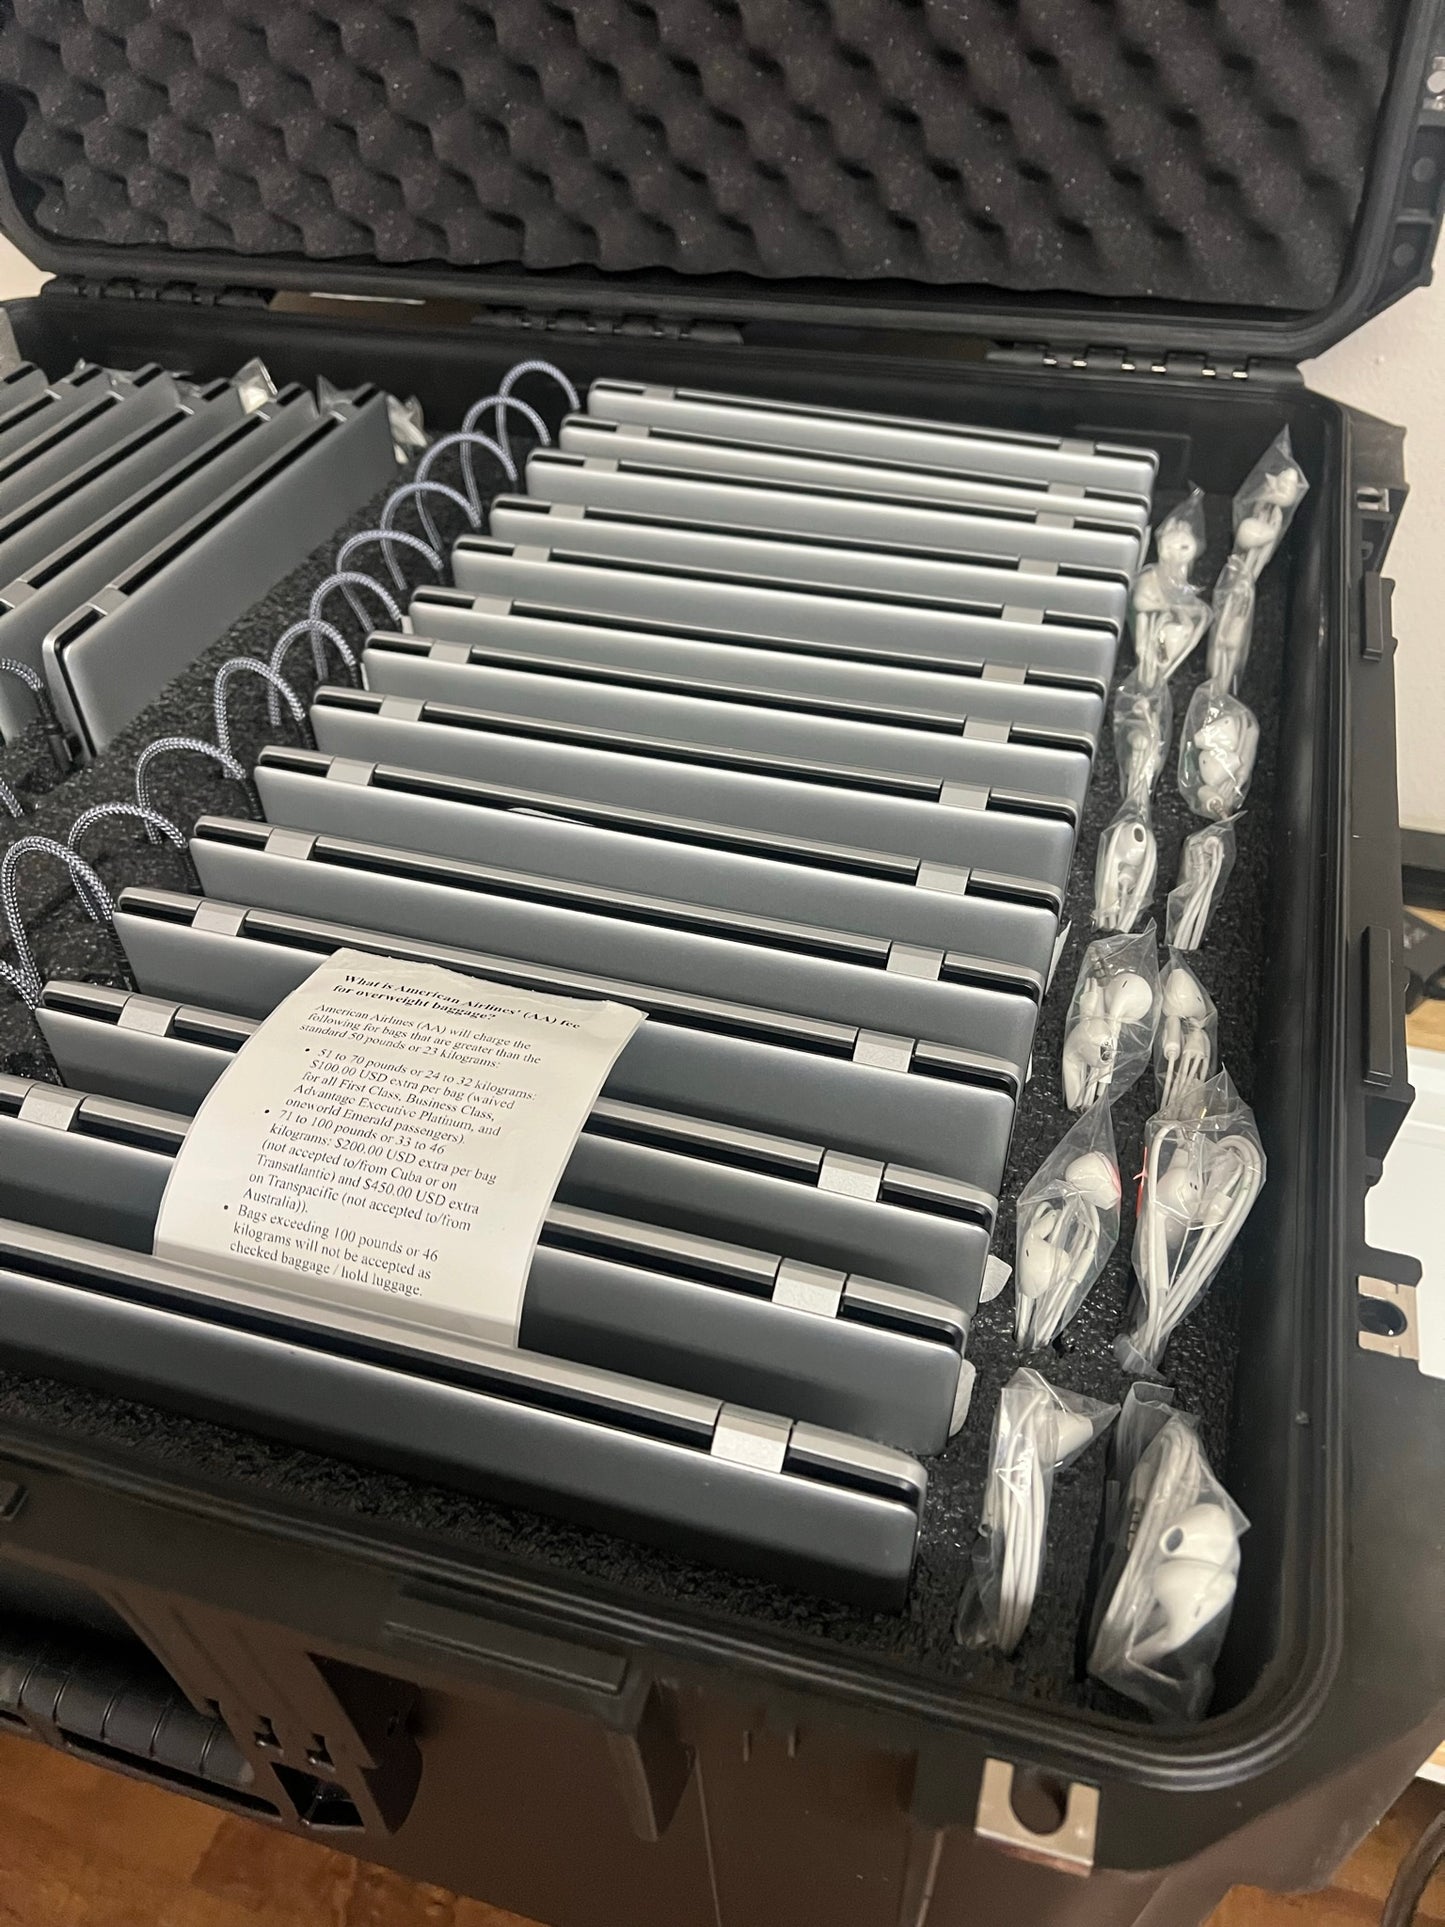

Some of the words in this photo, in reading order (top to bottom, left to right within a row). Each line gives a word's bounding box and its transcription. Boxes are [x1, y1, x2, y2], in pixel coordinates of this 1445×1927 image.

[315, 1004, 369, 1020] American
[370, 1013, 414, 1027] Airlines
[416, 1022, 447, 1034] (AA)
[450, 1027, 472, 1039] will
[473, 1032, 510, 1047] charge
[513, 1040, 531, 1050] the
[333, 984, 354, 994] for
[356, 990, 430, 1006] overweight
[432, 1002, 496, 1020] baggage?
[345, 975, 380, 988] What
[382, 982, 393, 990] is
[394, 985, 460, 1004] American
[523, 1012, 557, 1024] (AA)
[560, 1020, 580, 1029] fee
[299, 1023, 348, 1038] standard
[348, 1032, 364, 1041] 50
[363, 1036, 405, 1050] pounds
[408, 1045, 421, 1053] or
[422, 1047, 439, 1055] 23
[440, 1049, 501, 1068] kilograms:
[308, 1013, 361, 1031] following
[363, 1023, 380, 1033] for
[382, 1026, 407, 1039] bags
[410, 1032, 431, 1042] that
[433, 1038, 452, 1046] are
[452, 1041, 494, 1055] greater
[496, 1048, 520, 1060] than
[523, 1053, 541, 1064] the
[302, 1071, 320, 1083] for
[321, 1076, 338, 1087] all
[338, 1078, 365, 1093] First
[406, 1093, 457, 1113] Business
[309, 1059, 357, 1076] $100.00
[359, 1069, 388, 1083] USD
[390, 1078, 418, 1090] extra
[420, 1084, 442, 1095] per
[443, 1087, 465, 1101] bag
[467, 1092, 515, 1110] (waived
[335, 1052, 347, 1061] to
[352, 1054, 365, 1065] 70
[365, 1060, 408, 1074] pounds
[410, 1068, 424, 1077] or
[425, 1070, 441, 1080] 24
[443, 1075, 455, 1083] to
[457, 1076, 473, 1087] 32
[474, 1080, 537, 1101] kilograms:
[279, 1109, 293, 1121] 71
[295, 1114, 308, 1124] to
[311, 1117, 333, 1130] 100
[333, 1124, 378, 1140] pounds
[380, 1134, 394, 1143] or
[395, 1135, 412, 1147] 33
[414, 1140, 427, 1151] to
[429, 1143, 447, 1155] 46
[285, 1098, 342, 1117] oneworld
[342, 1109, 393, 1128] Emerald
[293, 1084, 356, 1105] Advantage
[358, 1097, 417, 1118] Executive
[418, 1110, 474, 1132] Platinum,
[478, 1126, 501, 1137] and
[261, 1139, 287, 1153] (not
[289, 1145, 341, 1165] accepted
[343, 1157, 387, 1175] to/from
[391, 1167, 422, 1183] Cuba
[425, 1177, 440, 1187] or
[441, 1180, 457, 1191] on
[270, 1123, 332, 1146] kilograms:
[334, 1137, 384, 1157] $200.00
[386, 1148, 416, 1164] USD
[418, 1158, 449, 1172] extra
[450, 1165, 472, 1177] per
[474, 1168, 497, 1185] bag
[249, 1173, 264, 1184] on
[268, 1174, 339, 1201] Transpacific
[341, 1192, 366, 1208] (not
[369, 1200, 423, 1220] accepted
[425, 1212, 471, 1231] to/from
[257, 1153, 336, 1183] Transatlantic)
[338, 1175, 361, 1188] and
[363, 1178, 413, 1199] $450.00
[415, 1189, 446, 1206] USD
[448, 1200, 479, 1215] extra
[233, 1221, 291, 1246] kilograms
[295, 1238, 318, 1252] will
[321, 1246, 340, 1259] not
[344, 1248, 359, 1262] be
[361, 1255, 415, 1275] accepted
[418, 1269, 431, 1280] as
[238, 1204, 267, 1223] Bags
[270, 1215, 330, 1239] exceeding
[334, 1227, 356, 1243] 100
[358, 1235, 403, 1254] pounds
[406, 1247, 420, 1257] or
[422, 1248, 439, 1262] 46
[230, 1240, 278, 1261] checked
[281, 1251, 331, 1275] baggage
[341, 1265, 368, 1283] hold
[372, 1273, 423, 1297] luggage.
